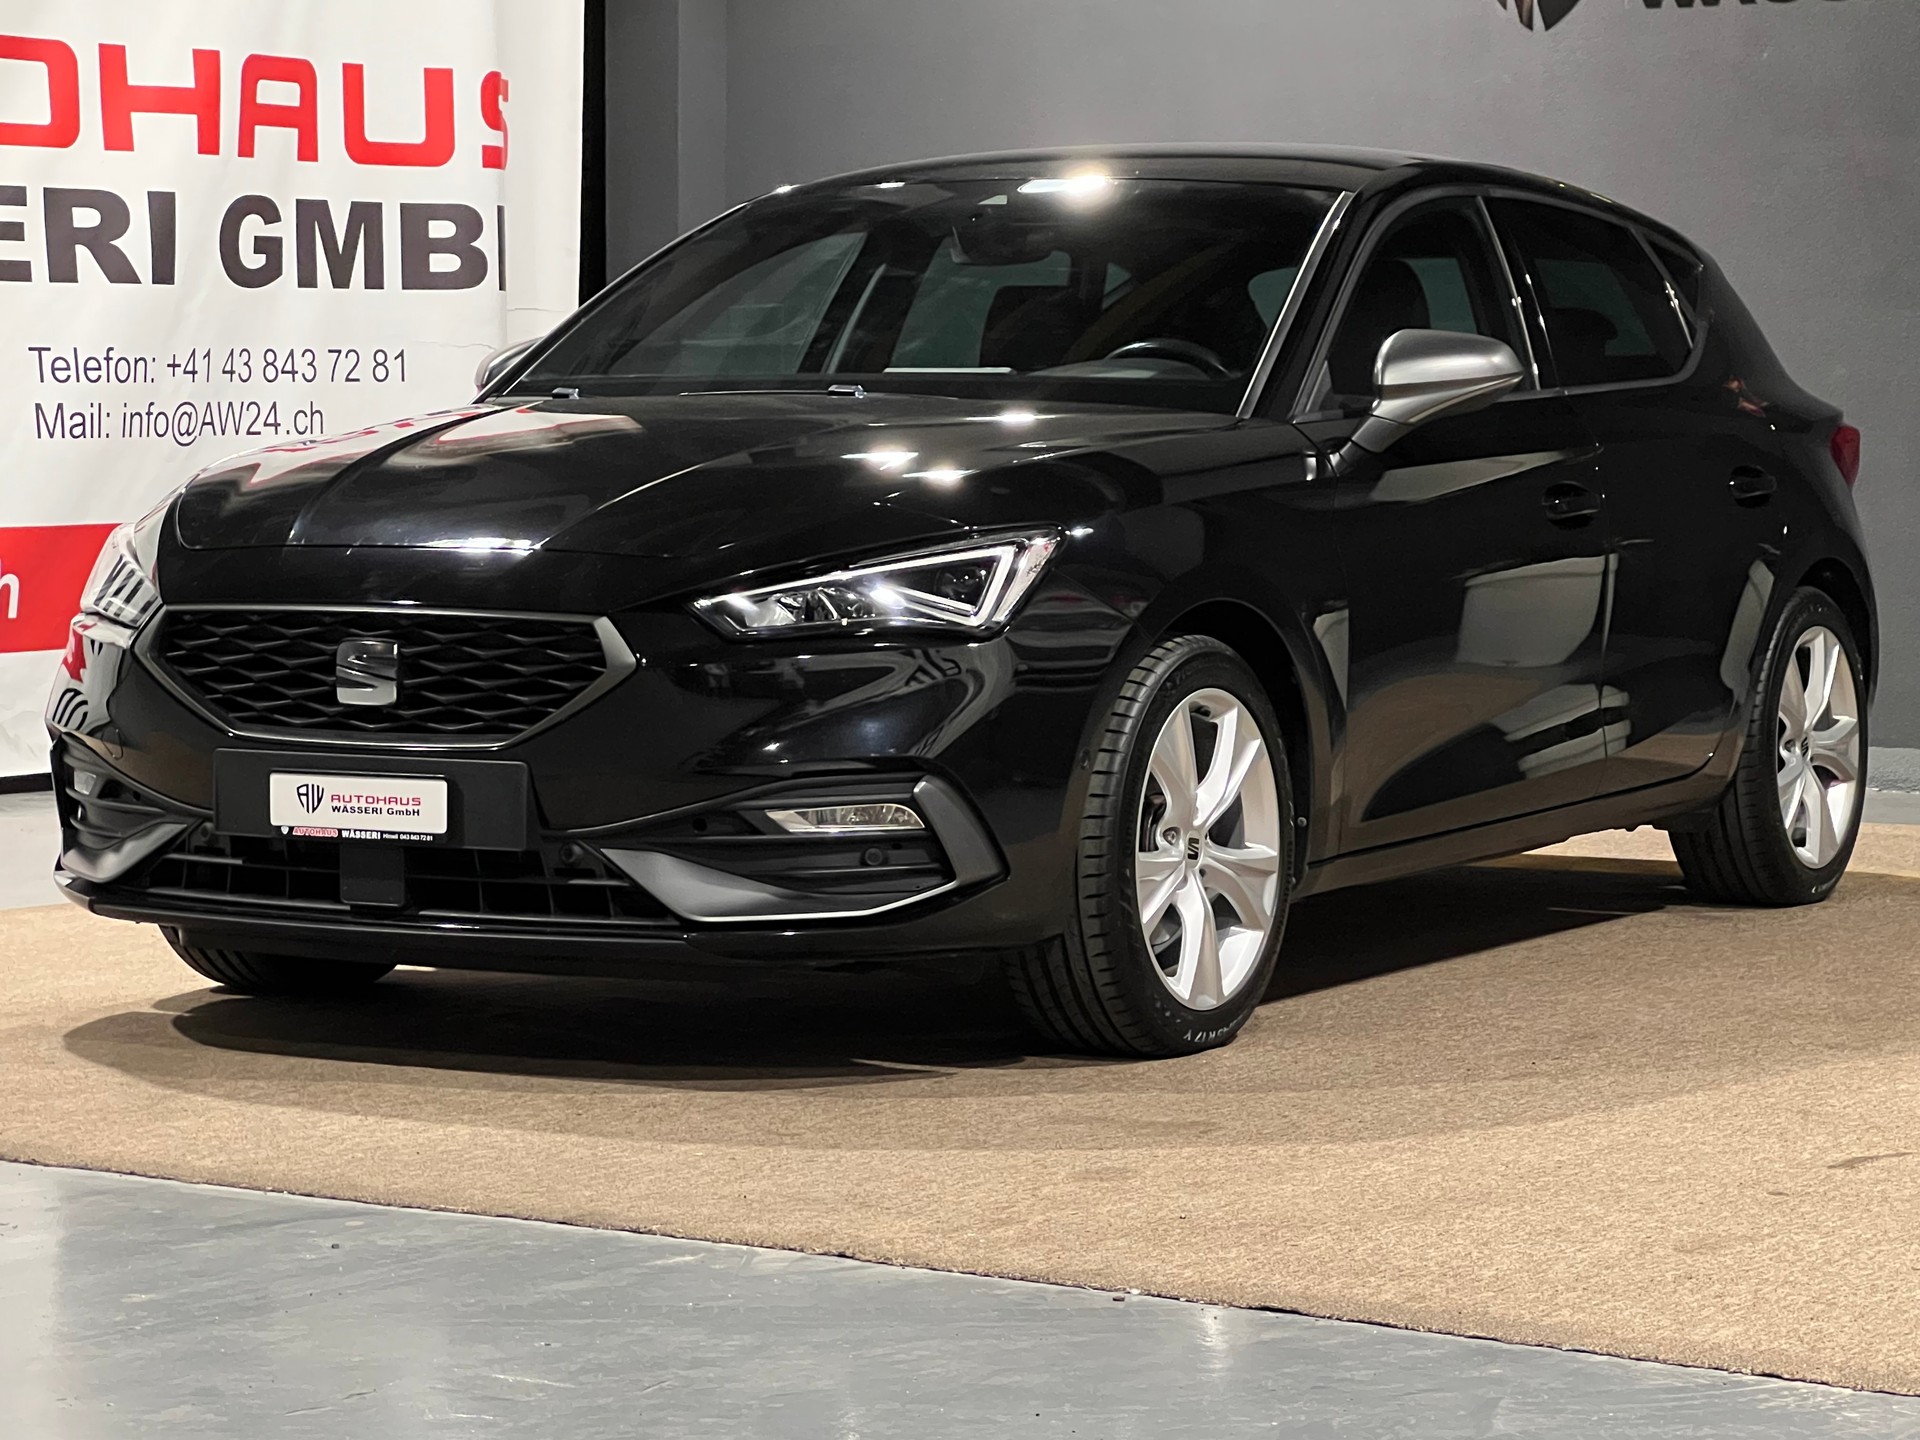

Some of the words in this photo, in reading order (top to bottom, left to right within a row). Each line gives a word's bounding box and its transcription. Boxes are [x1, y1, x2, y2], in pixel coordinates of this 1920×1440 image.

[28, 346, 156, 384] Telefon:
[166, 347, 212, 383] +41
[221, 348, 252, 383] 43
[262, 348, 318, 384] 843
[327, 348, 361, 383] 72
[372, 348, 406, 383] 81
[34, 402, 111, 440] Mail:
[121, 400, 324, 447] info@AW24.ch
[331, 794, 420, 806] AUTOHAUS
[332, 805, 382, 814] WÄSSERI
[386, 808, 420, 816] GmbH
[292, 827, 338, 838] AUTOHAUS
[342, 830, 380, 840] WÄSSERI
